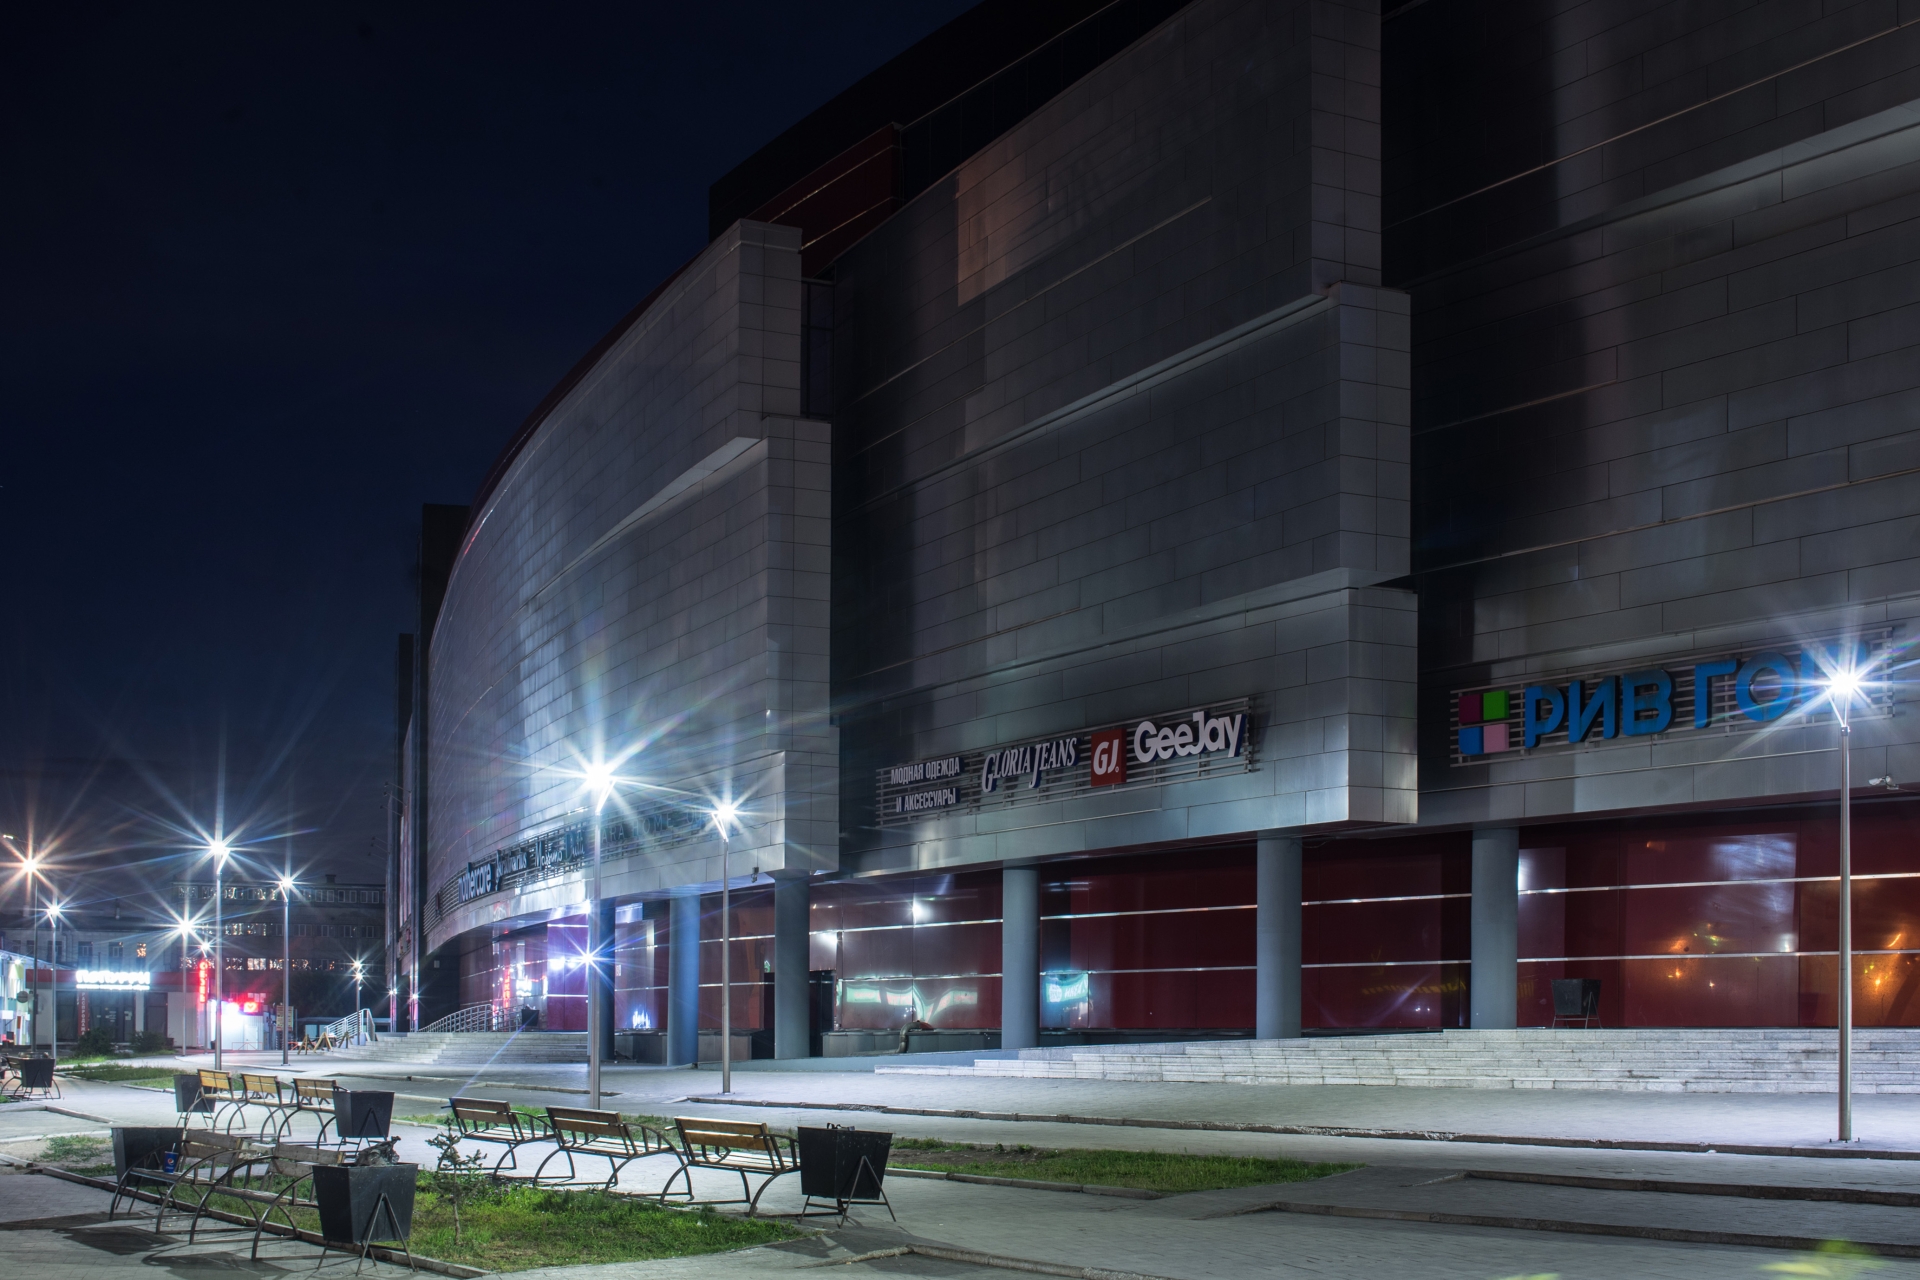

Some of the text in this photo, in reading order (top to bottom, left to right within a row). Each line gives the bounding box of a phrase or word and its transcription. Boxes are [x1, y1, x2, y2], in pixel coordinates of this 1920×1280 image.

[1524, 669, 1675, 748] РИВ
[1133, 711, 1246, 763] GeeJay
[890, 757, 961, 785] МОДНАЯ ОДЕЖДА
[981, 737, 1079, 792] GLORIA JEANS
[896, 788, 957, 812] И АКСЕССУАРЫ
[458, 862, 493, 903] mothercare
